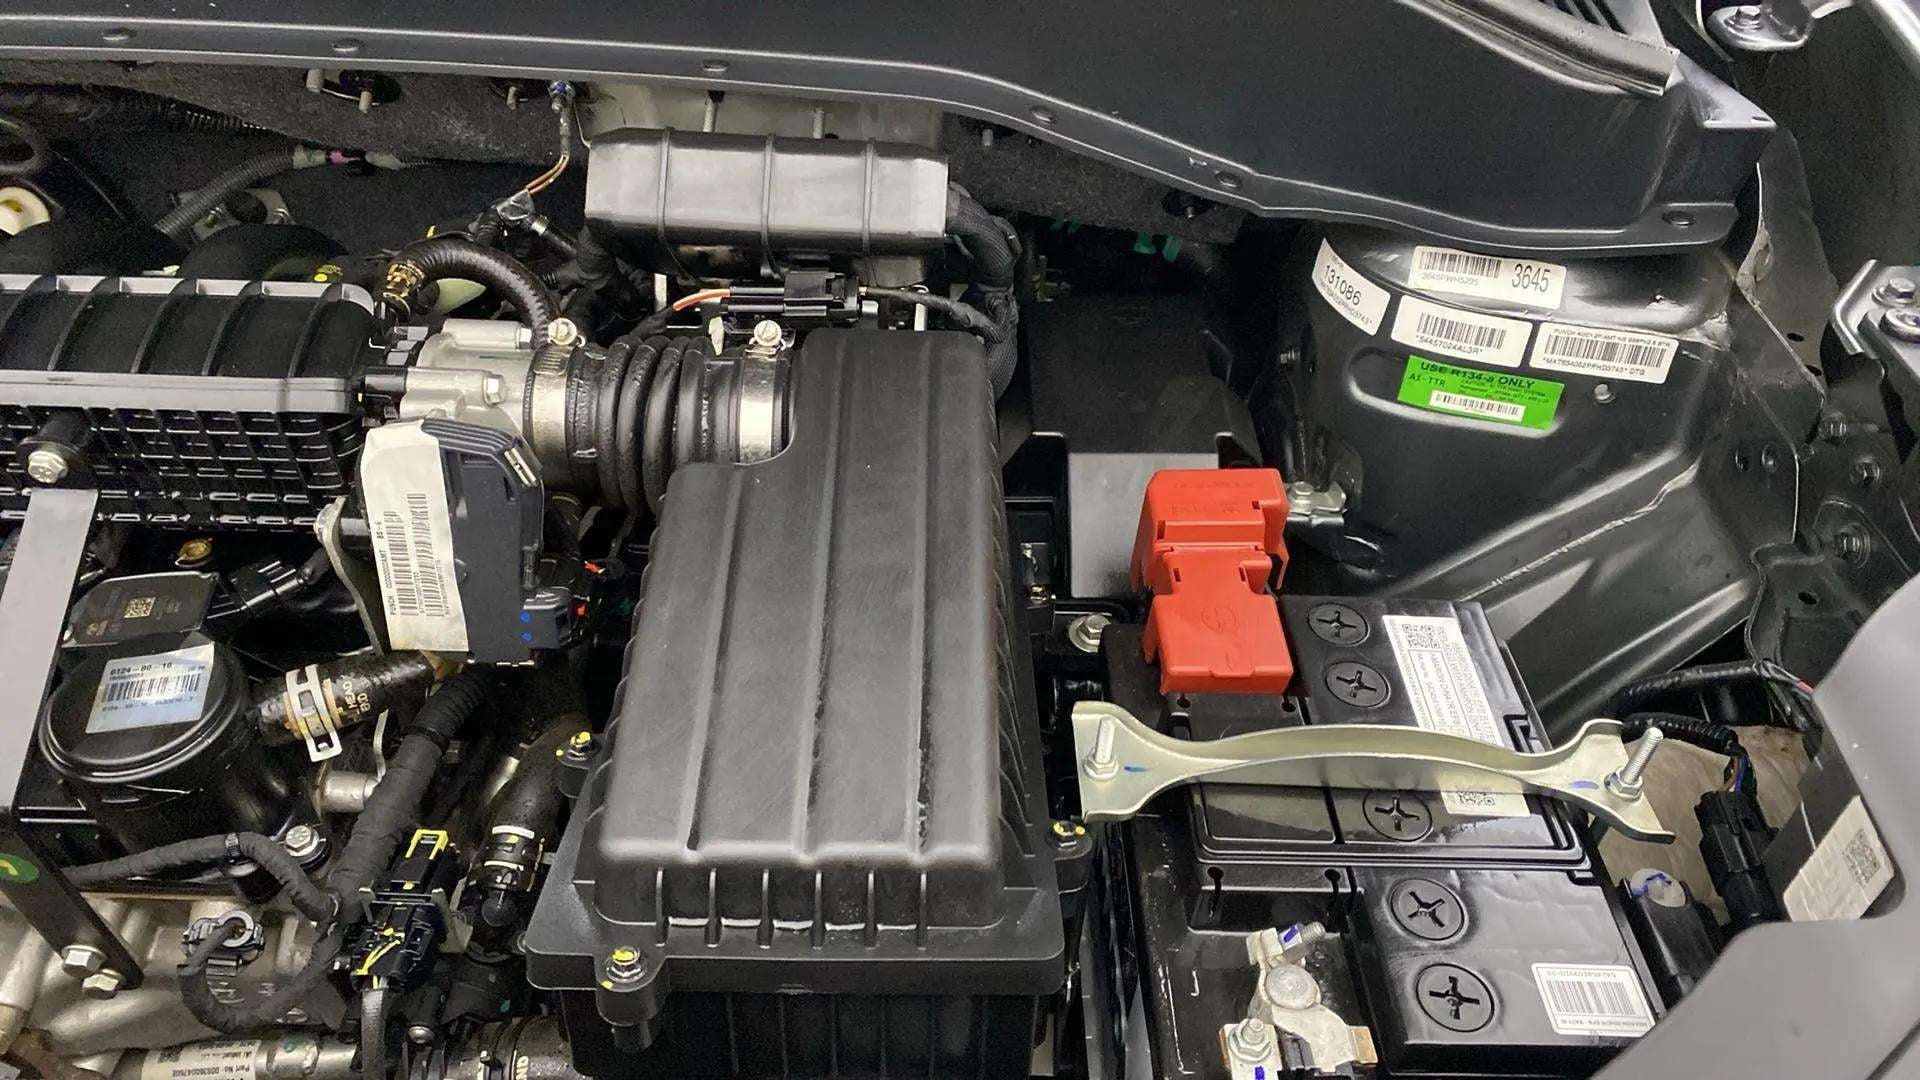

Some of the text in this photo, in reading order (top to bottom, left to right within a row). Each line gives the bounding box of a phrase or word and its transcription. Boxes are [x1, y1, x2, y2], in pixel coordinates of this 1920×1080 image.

[1326, 265, 1361, 306] 131086
[1512, 263, 1551, 293] 3645
[1421, 361, 1536, 389] USE R134-a ONLY
[343, 680, 358, 709] HEAD
[235, 1065, 250, 1073] Part
